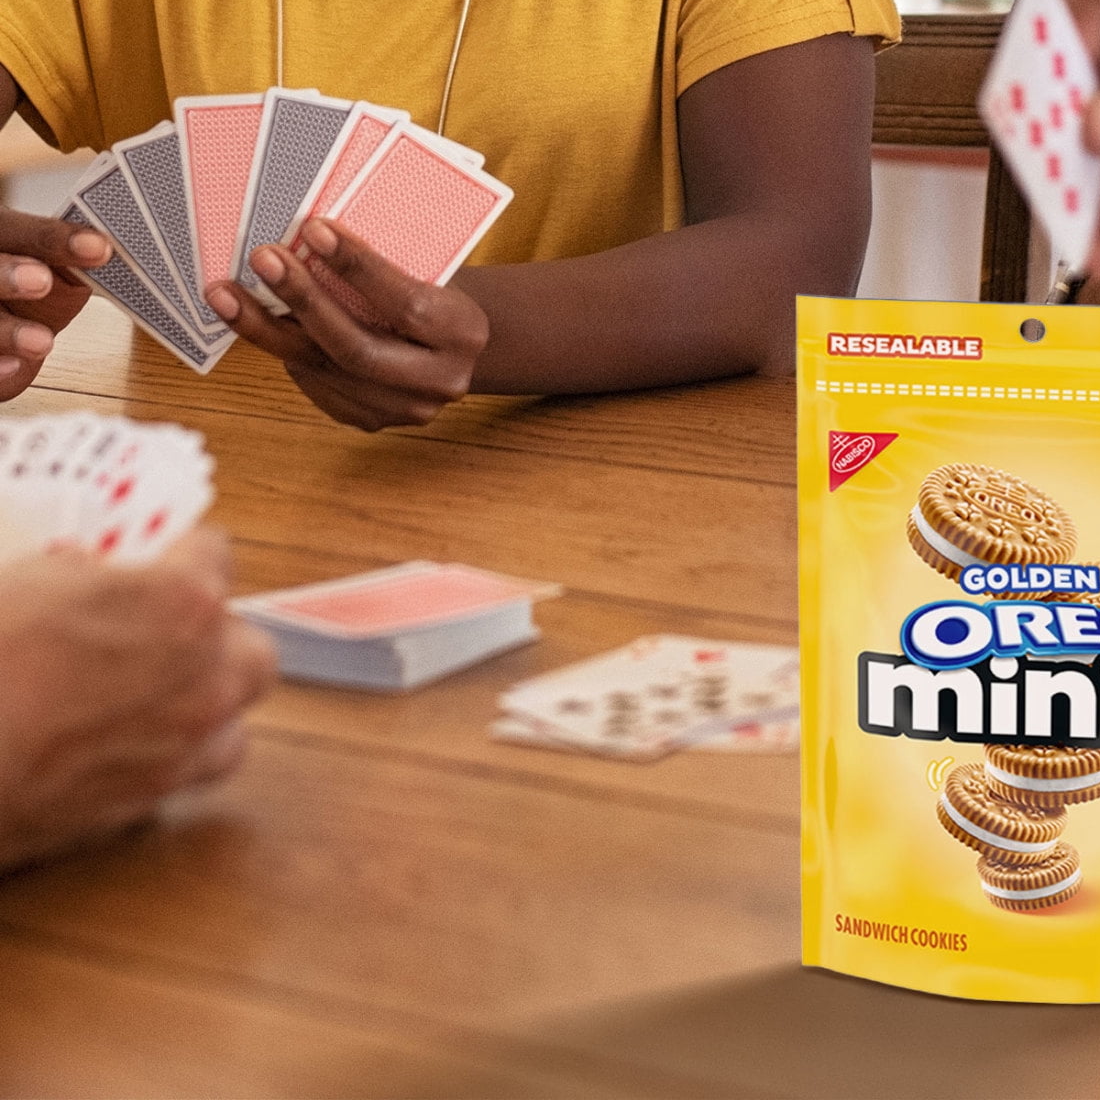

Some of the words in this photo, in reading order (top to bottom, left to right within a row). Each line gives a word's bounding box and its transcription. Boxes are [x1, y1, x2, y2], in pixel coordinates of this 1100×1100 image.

[830, 336, 979, 357] RESEALABLE
[835, 439, 872, 470] NABISCO
[974, 491, 1035, 521] OREO
[963, 567, 1098, 592] GOLDEN
[835, 913, 908, 944] SANDWICH
[911, 928, 968, 952] COOKIES
